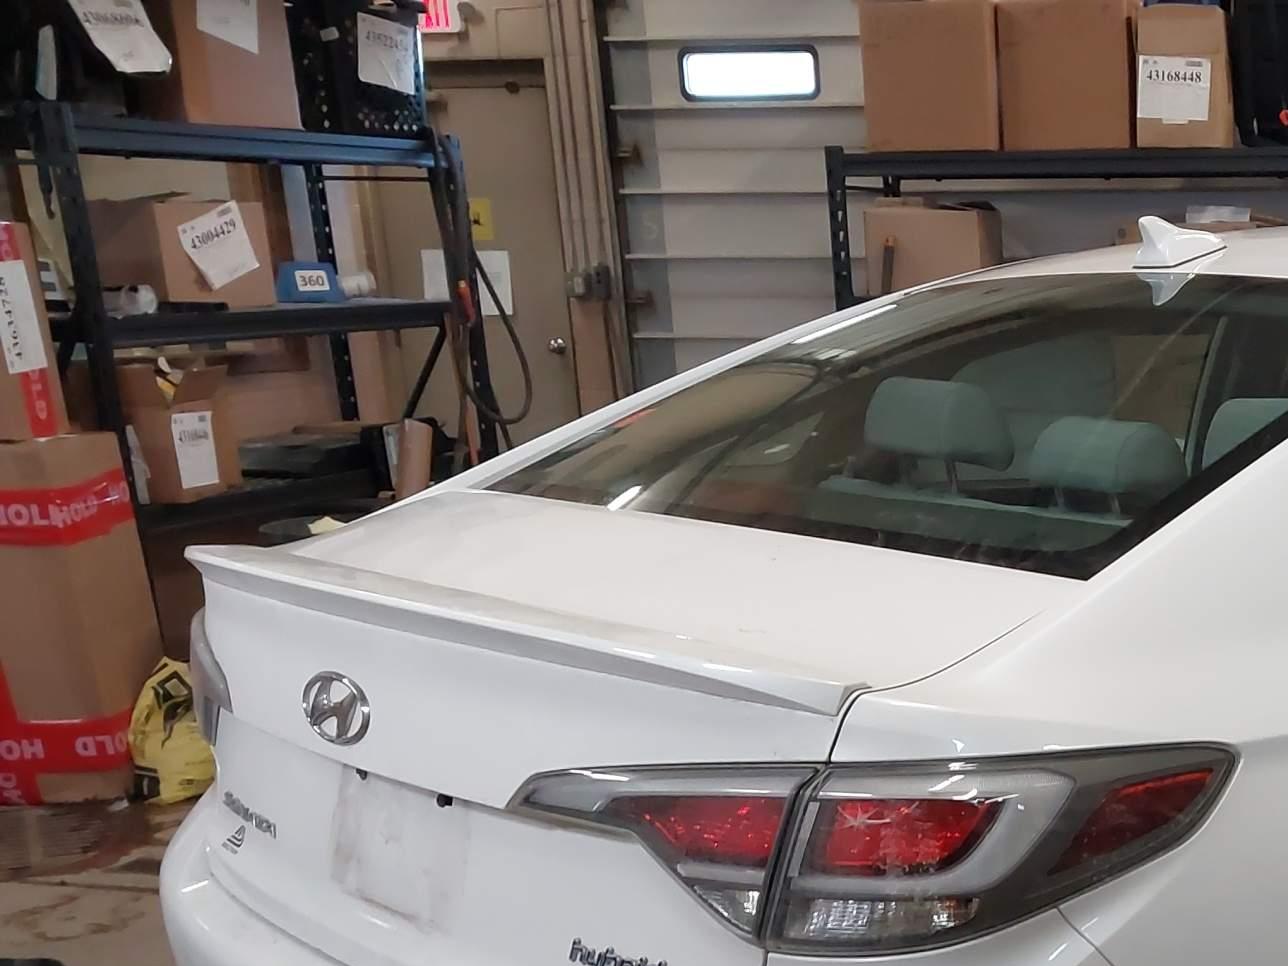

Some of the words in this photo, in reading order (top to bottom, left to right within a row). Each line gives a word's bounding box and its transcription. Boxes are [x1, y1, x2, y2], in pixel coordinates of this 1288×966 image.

[1146, 69, 1202, 83] 43168448
[190, 218, 237, 249] 43004429
[299, 275, 325, 287] 360
